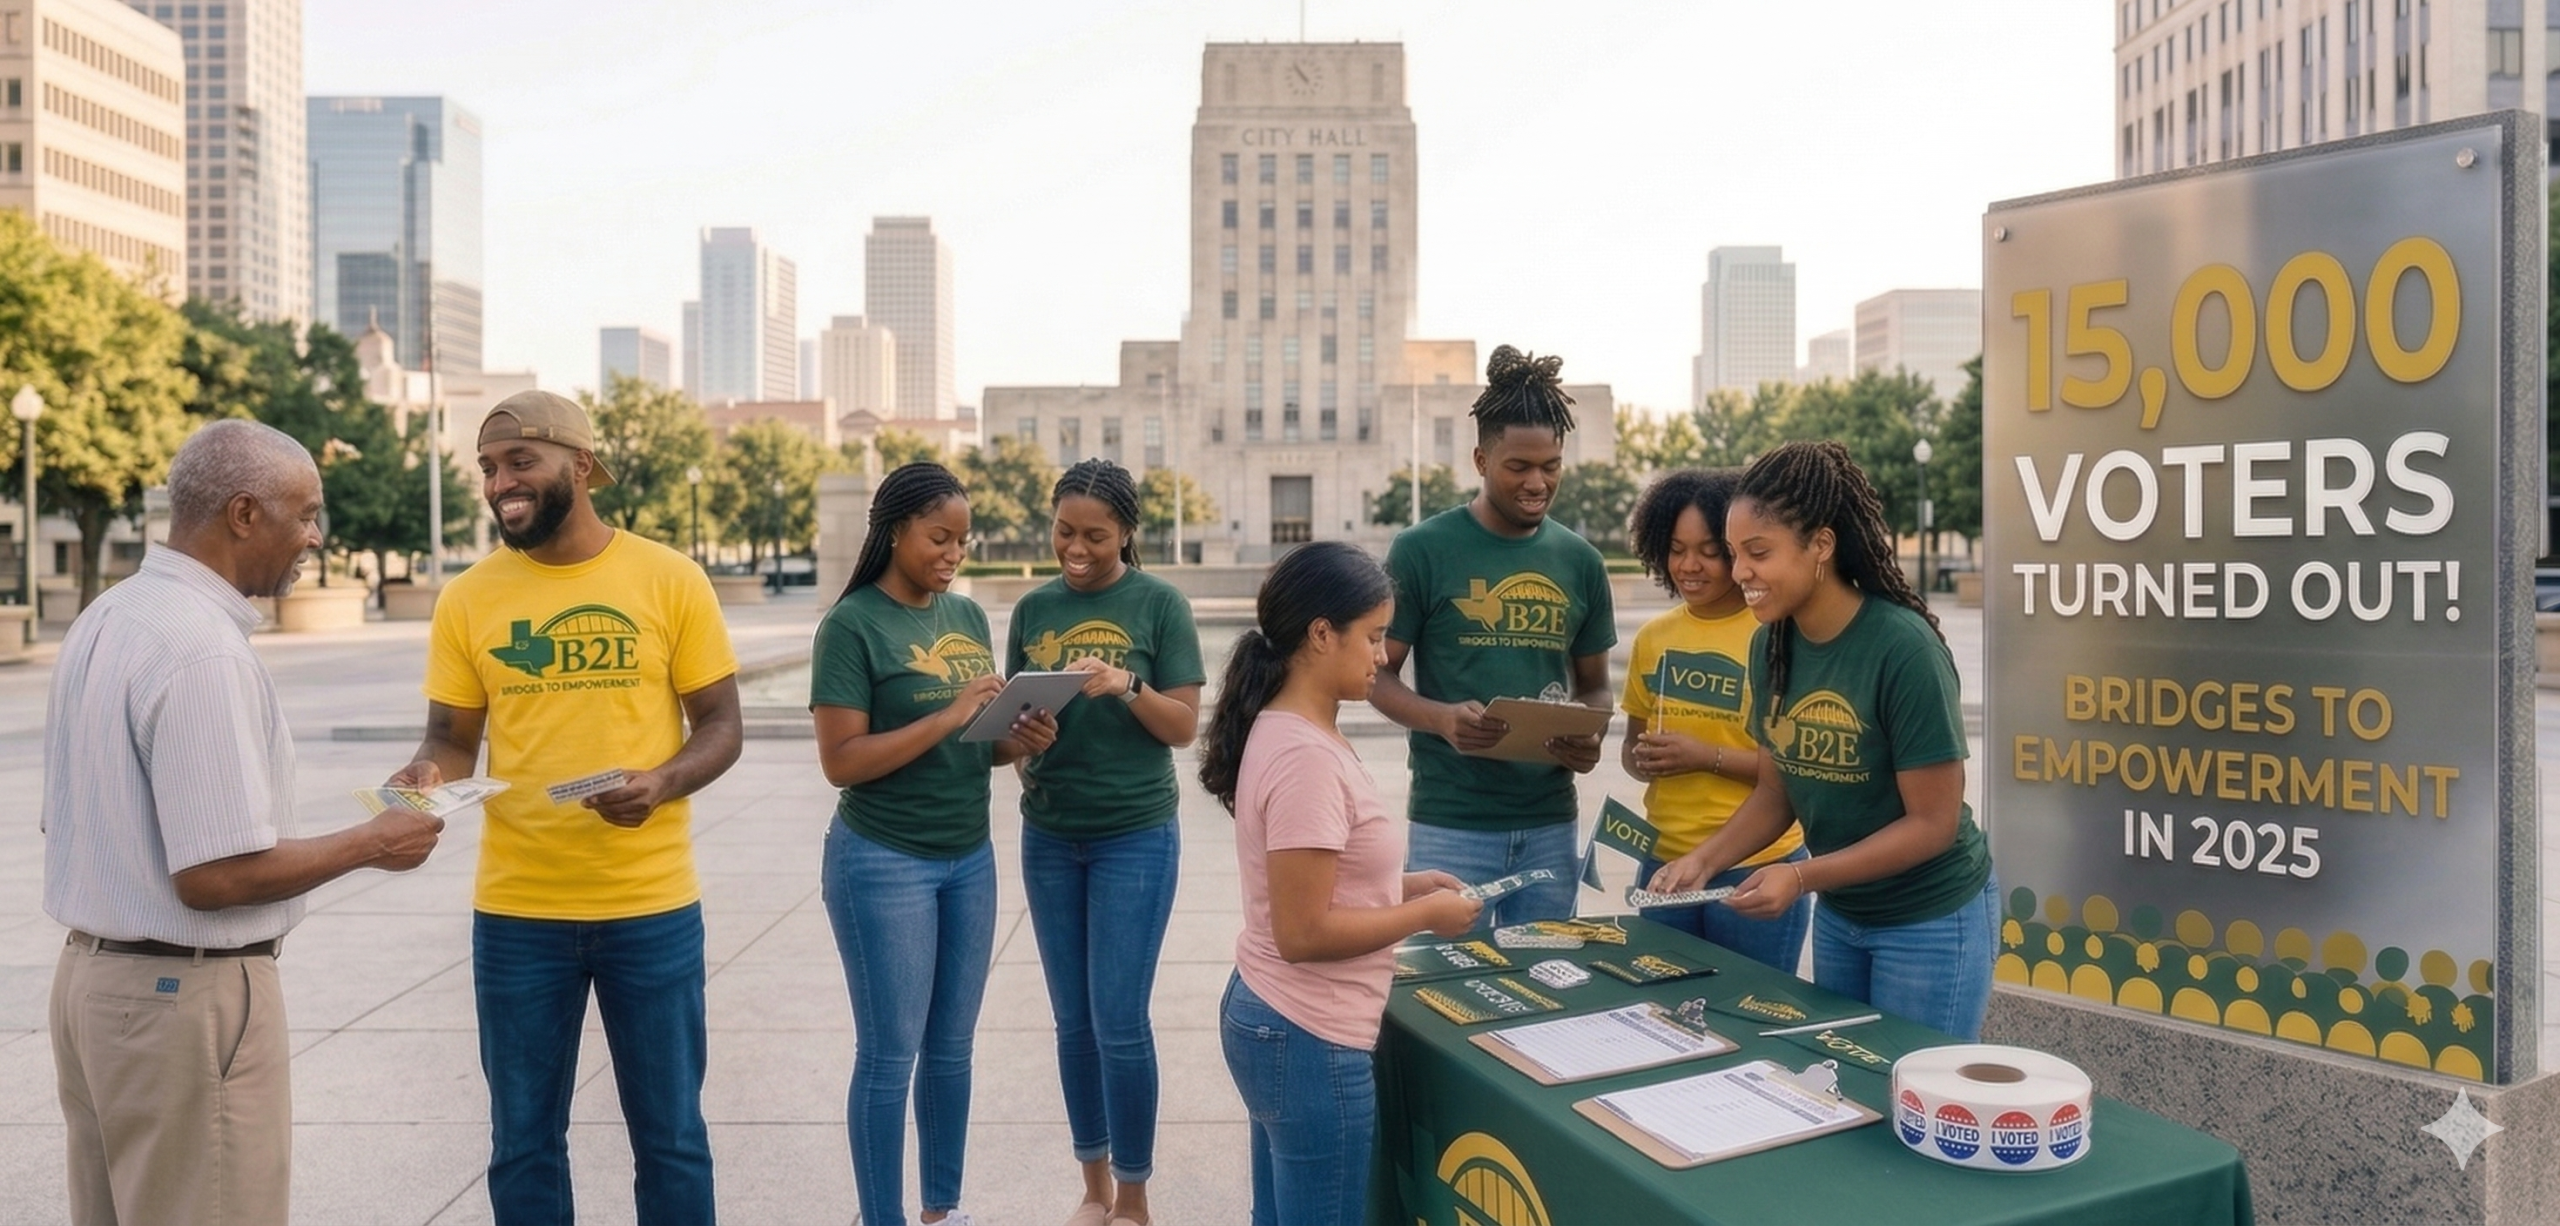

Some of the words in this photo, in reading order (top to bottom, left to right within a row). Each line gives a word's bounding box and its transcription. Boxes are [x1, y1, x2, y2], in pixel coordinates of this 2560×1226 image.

[1242, 128, 1294, 146] CITY
[1310, 128, 1367, 146] HALL
[2012, 236, 2461, 429] 15,000
[2015, 431, 2454, 542] VOTERS
[2013, 563, 2270, 619] TURNED
[2291, 561, 2461, 622] OUT!
[1505, 602, 1567, 636] B2E
[556, 636, 640, 674] B2E
[546, 682, 561, 692] TO
[562, 678, 641, 691] EMPOWERMENT
[1670, 665, 1738, 697] VOTE
[2065, 674, 2296, 736] BRIDGES
[2312, 686, 2393, 742] TO
[1797, 726, 1861, 766] B2E
[2013, 735, 2461, 819] EMPOWERMENT
[1605, 813, 1652, 852] VOTE
[2124, 809, 2174, 861] IN
[2190, 816, 2322, 879] 2025
[1942, 1122, 1980, 1143] VOTED
[1992, 1130, 1996, 1144] I
[1999, 1130, 2039, 1146] VOTED
